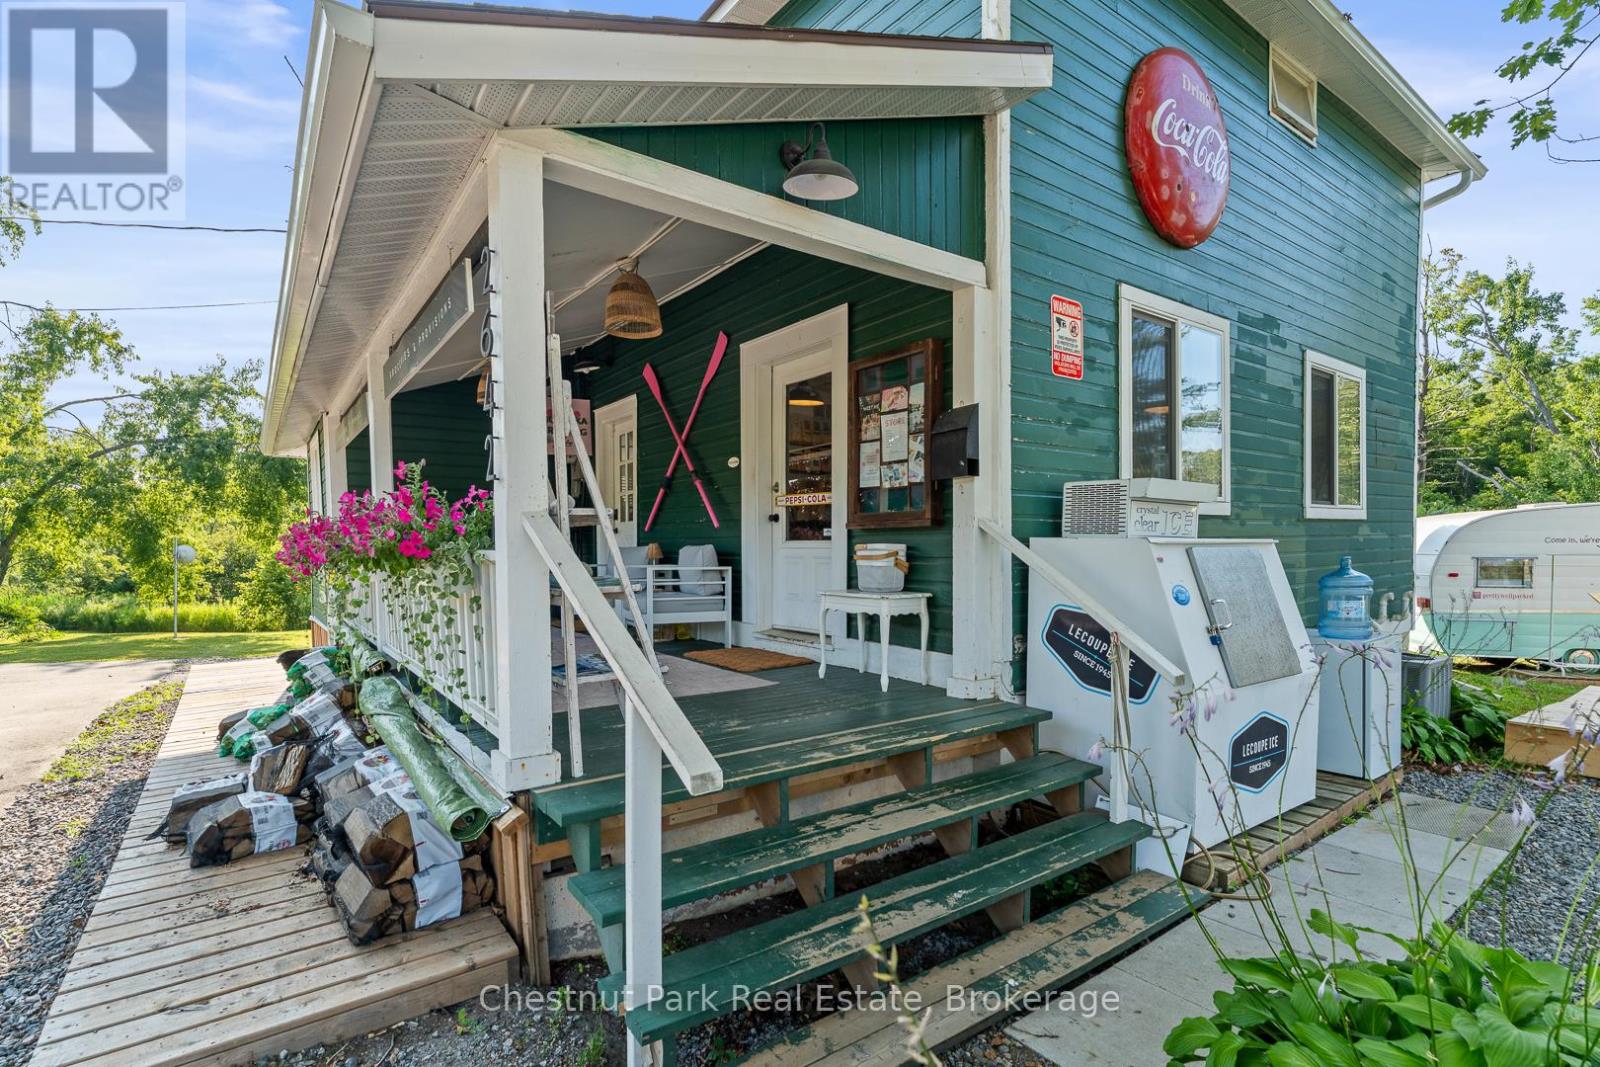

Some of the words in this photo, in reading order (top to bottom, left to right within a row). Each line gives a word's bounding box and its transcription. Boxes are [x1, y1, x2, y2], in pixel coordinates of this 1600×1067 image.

[1182, 73, 1211, 109] Drink
[418, 296, 452, 344] PROVISIONS
[1136, 506, 1160, 516] crystal
[1544, 536, 1567, 544] Come
[1068, 624, 1112, 658] LECOUPE
[1073, 650, 1096, 669] SINCE
[1242, 738, 1268, 757] LECOUPE
[1269, 735, 1279, 749] ICE
